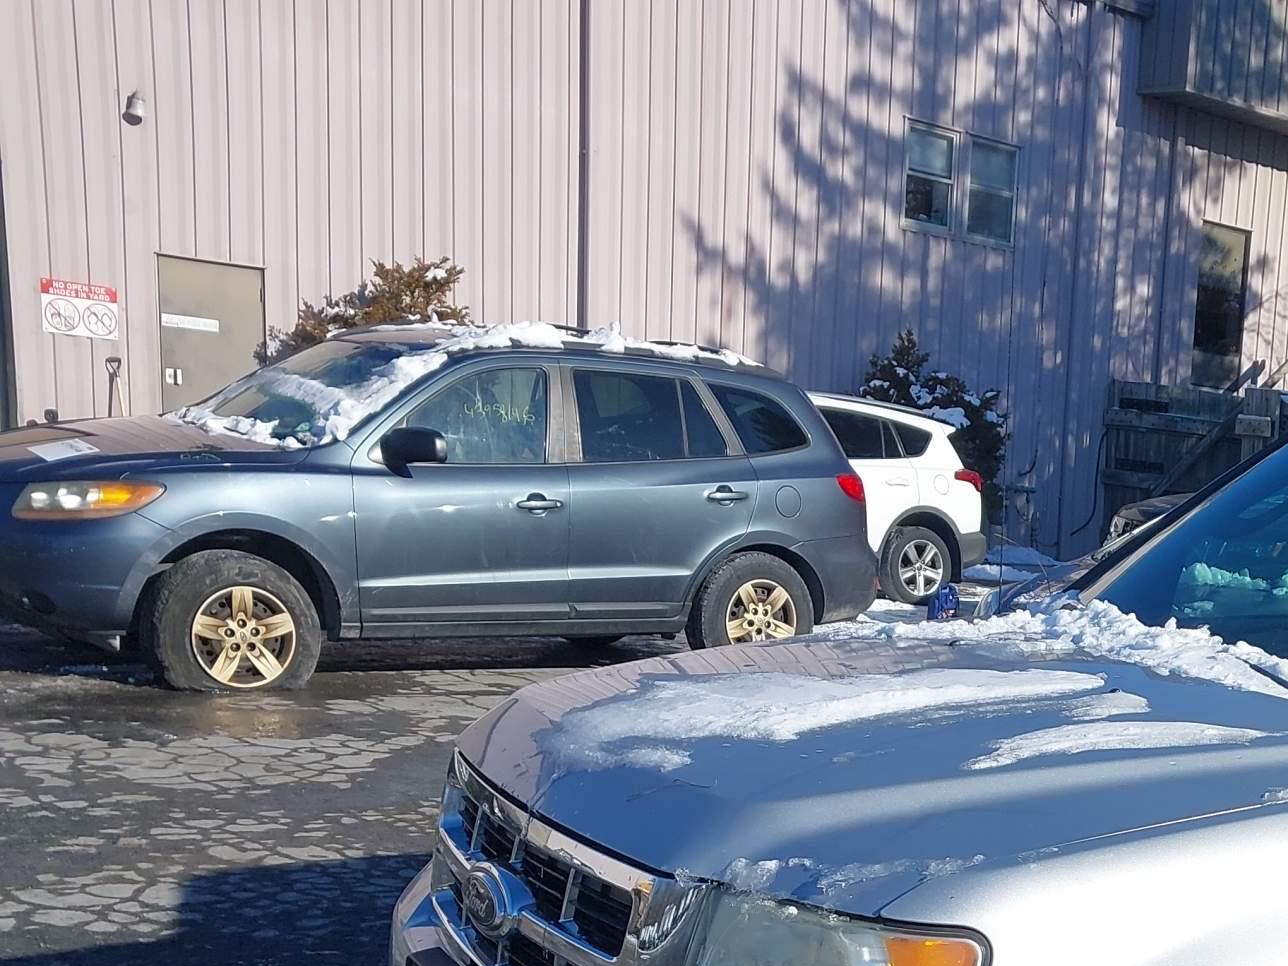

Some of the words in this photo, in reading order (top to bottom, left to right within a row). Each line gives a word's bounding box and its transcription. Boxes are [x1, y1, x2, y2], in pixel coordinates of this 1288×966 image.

[48, 287, 76, 297] SHOES
[77, 290, 87, 299] IN
[88, 293, 110, 302] YARD
[52, 280, 65, 289] NO
[66, 282, 89, 293] OPEN
[90, 286, 106, 295] TOE
